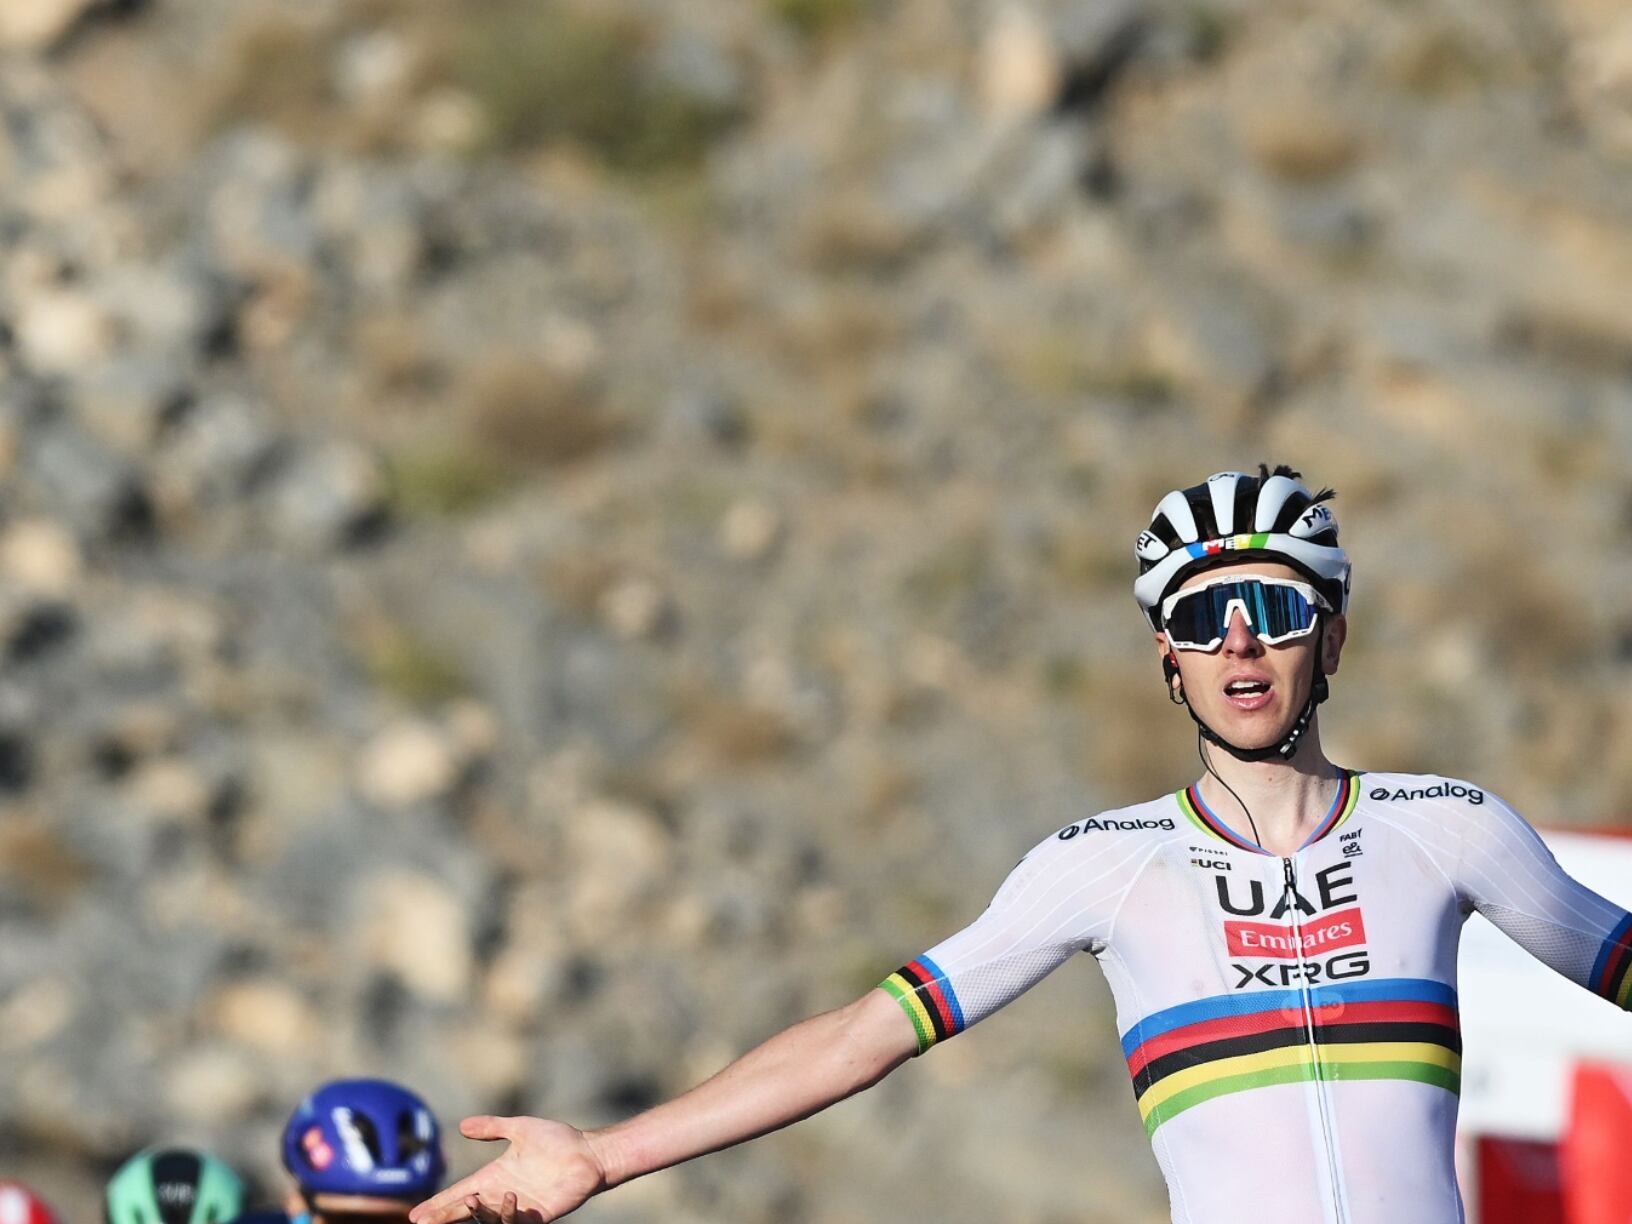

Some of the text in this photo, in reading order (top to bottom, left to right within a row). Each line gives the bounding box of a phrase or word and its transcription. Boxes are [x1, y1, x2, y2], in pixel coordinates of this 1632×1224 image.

[1391, 782, 1485, 806] Analog
[1082, 818, 1176, 835] Analog
[1198, 858, 1232, 871] UCI
[1215, 861, 1358, 919] UAE
[1239, 922, 1353, 951] Emirates
[1231, 951, 1370, 989] XRG
